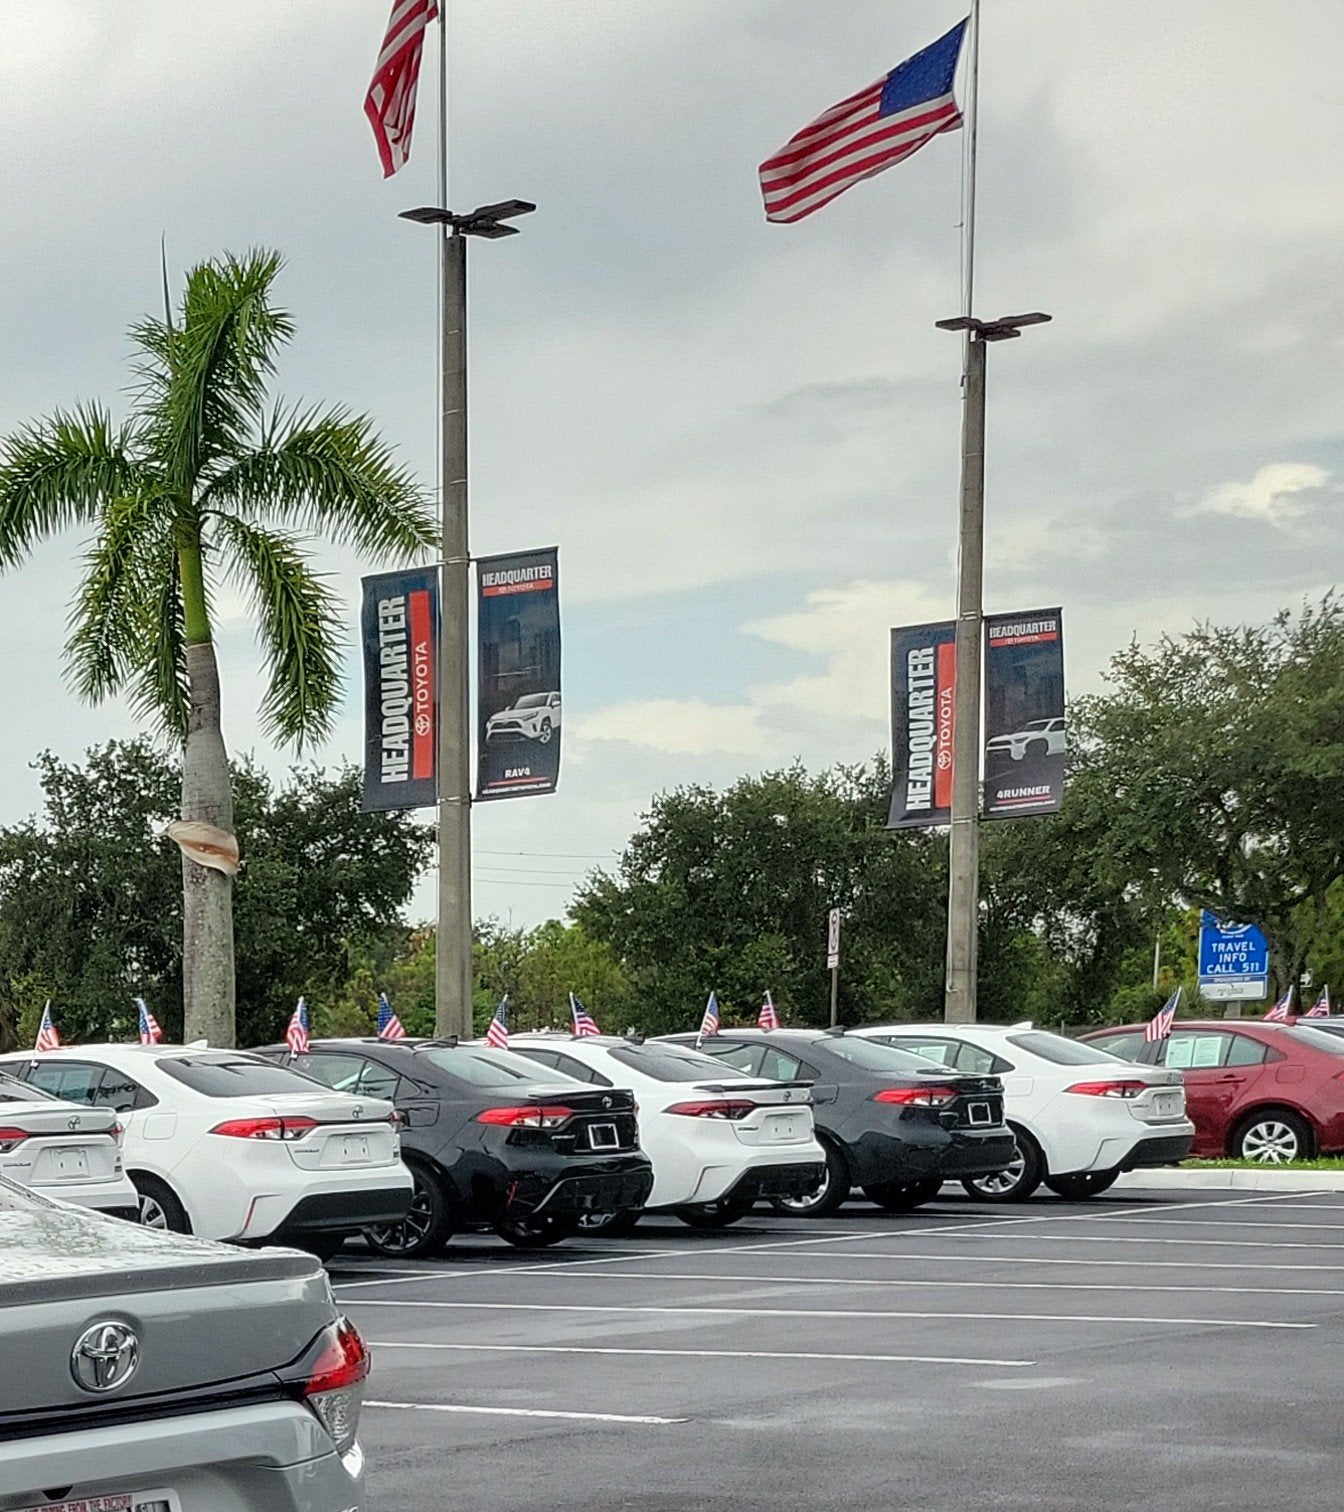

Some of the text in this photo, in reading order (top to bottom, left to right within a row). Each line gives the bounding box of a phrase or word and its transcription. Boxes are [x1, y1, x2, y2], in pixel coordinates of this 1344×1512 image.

[482, 565, 552, 587] HEADQUARTER
[989, 620, 1056, 639] HEADQUARTER
[415, 641, 429, 713] TOYOTA
[378, 595, 413, 783] HEADQUARTER
[940, 687, 952, 748] TOYOTA
[906, 647, 937, 811] HEADQUARTER
[504, 767, 530, 779] RAV4
[996, 785, 1050, 799] 4RUNNER
[1211, 941, 1256, 953] TRAVEL
[1219, 952, 1247, 963] INFO
[1206, 962, 1260, 974] CALL 511
